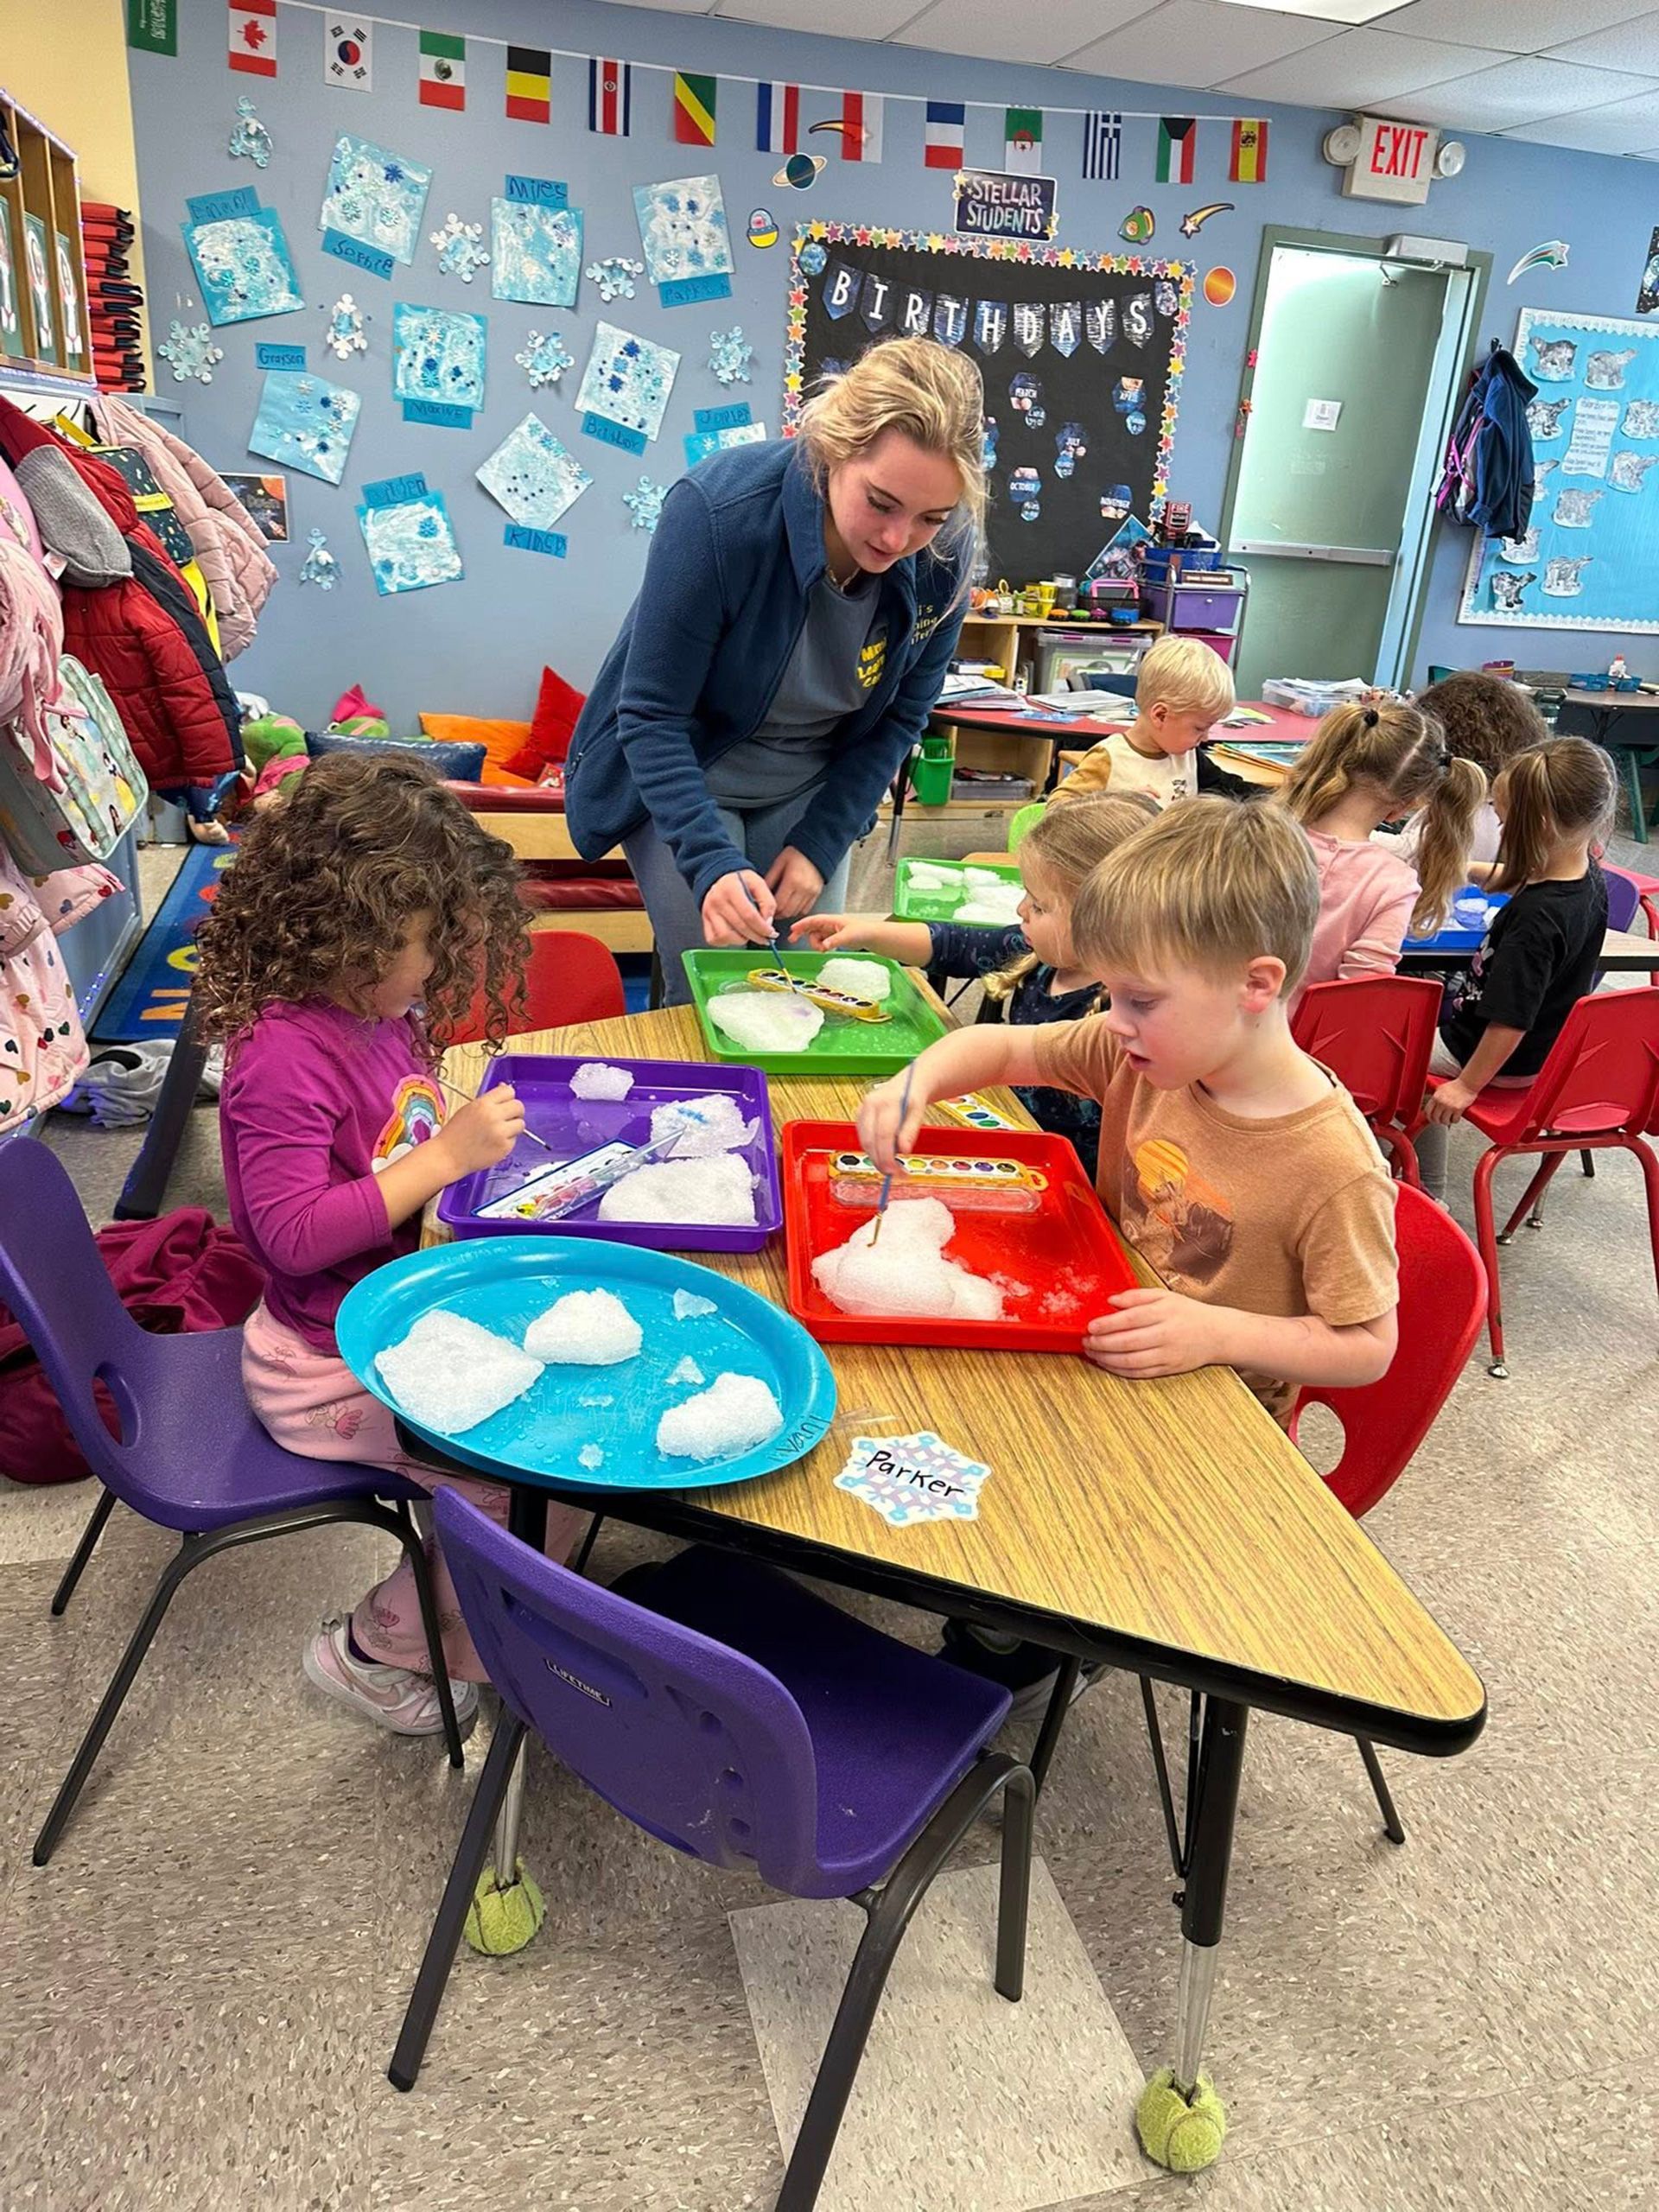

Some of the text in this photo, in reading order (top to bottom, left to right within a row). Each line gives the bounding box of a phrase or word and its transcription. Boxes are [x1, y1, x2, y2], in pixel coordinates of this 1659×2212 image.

[1370, 124, 1428, 179] EXIT
[971, 176, 1042, 207] STELLAR
[966, 200, 1044, 235] STUDENTS
[830, 270, 1148, 346] BIRTHDAYS
[1015, 387, 1037, 398] MARCH
[1065, 437, 1080, 446] JULY
[1010, 481, 1036, 492] OCTOBER
[1101, 497, 1130, 509] NOVEMBER
[1172, 503, 1190, 513] FIRE
[865, 1449, 964, 1497] Parker
